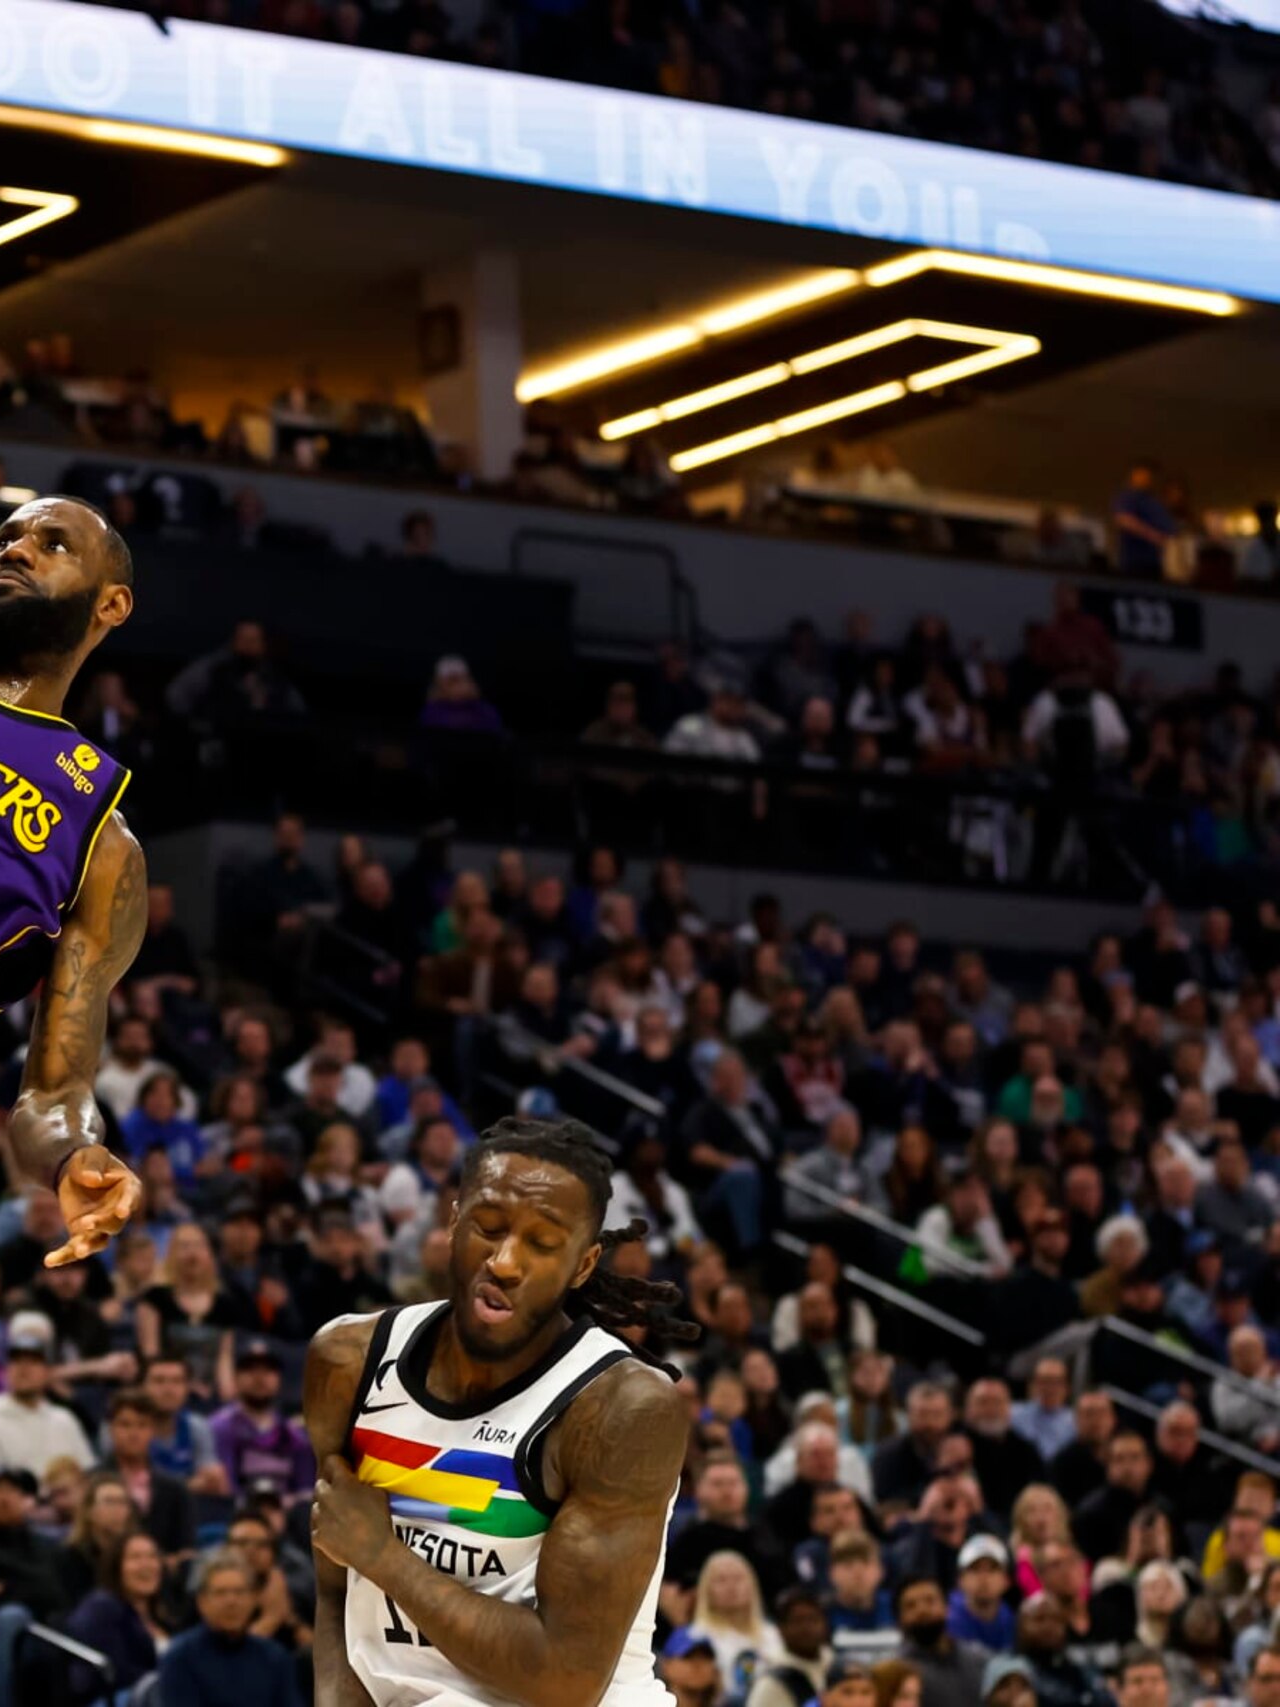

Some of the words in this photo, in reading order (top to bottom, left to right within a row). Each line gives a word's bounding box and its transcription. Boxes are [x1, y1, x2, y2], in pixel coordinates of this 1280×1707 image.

[184, 36, 288, 137] IT
[337, 60, 545, 176] ALL
[594, 104, 709, 206] IN
[55, 752, 94, 795] bibigo
[384, 1592, 434, 1647] 1
